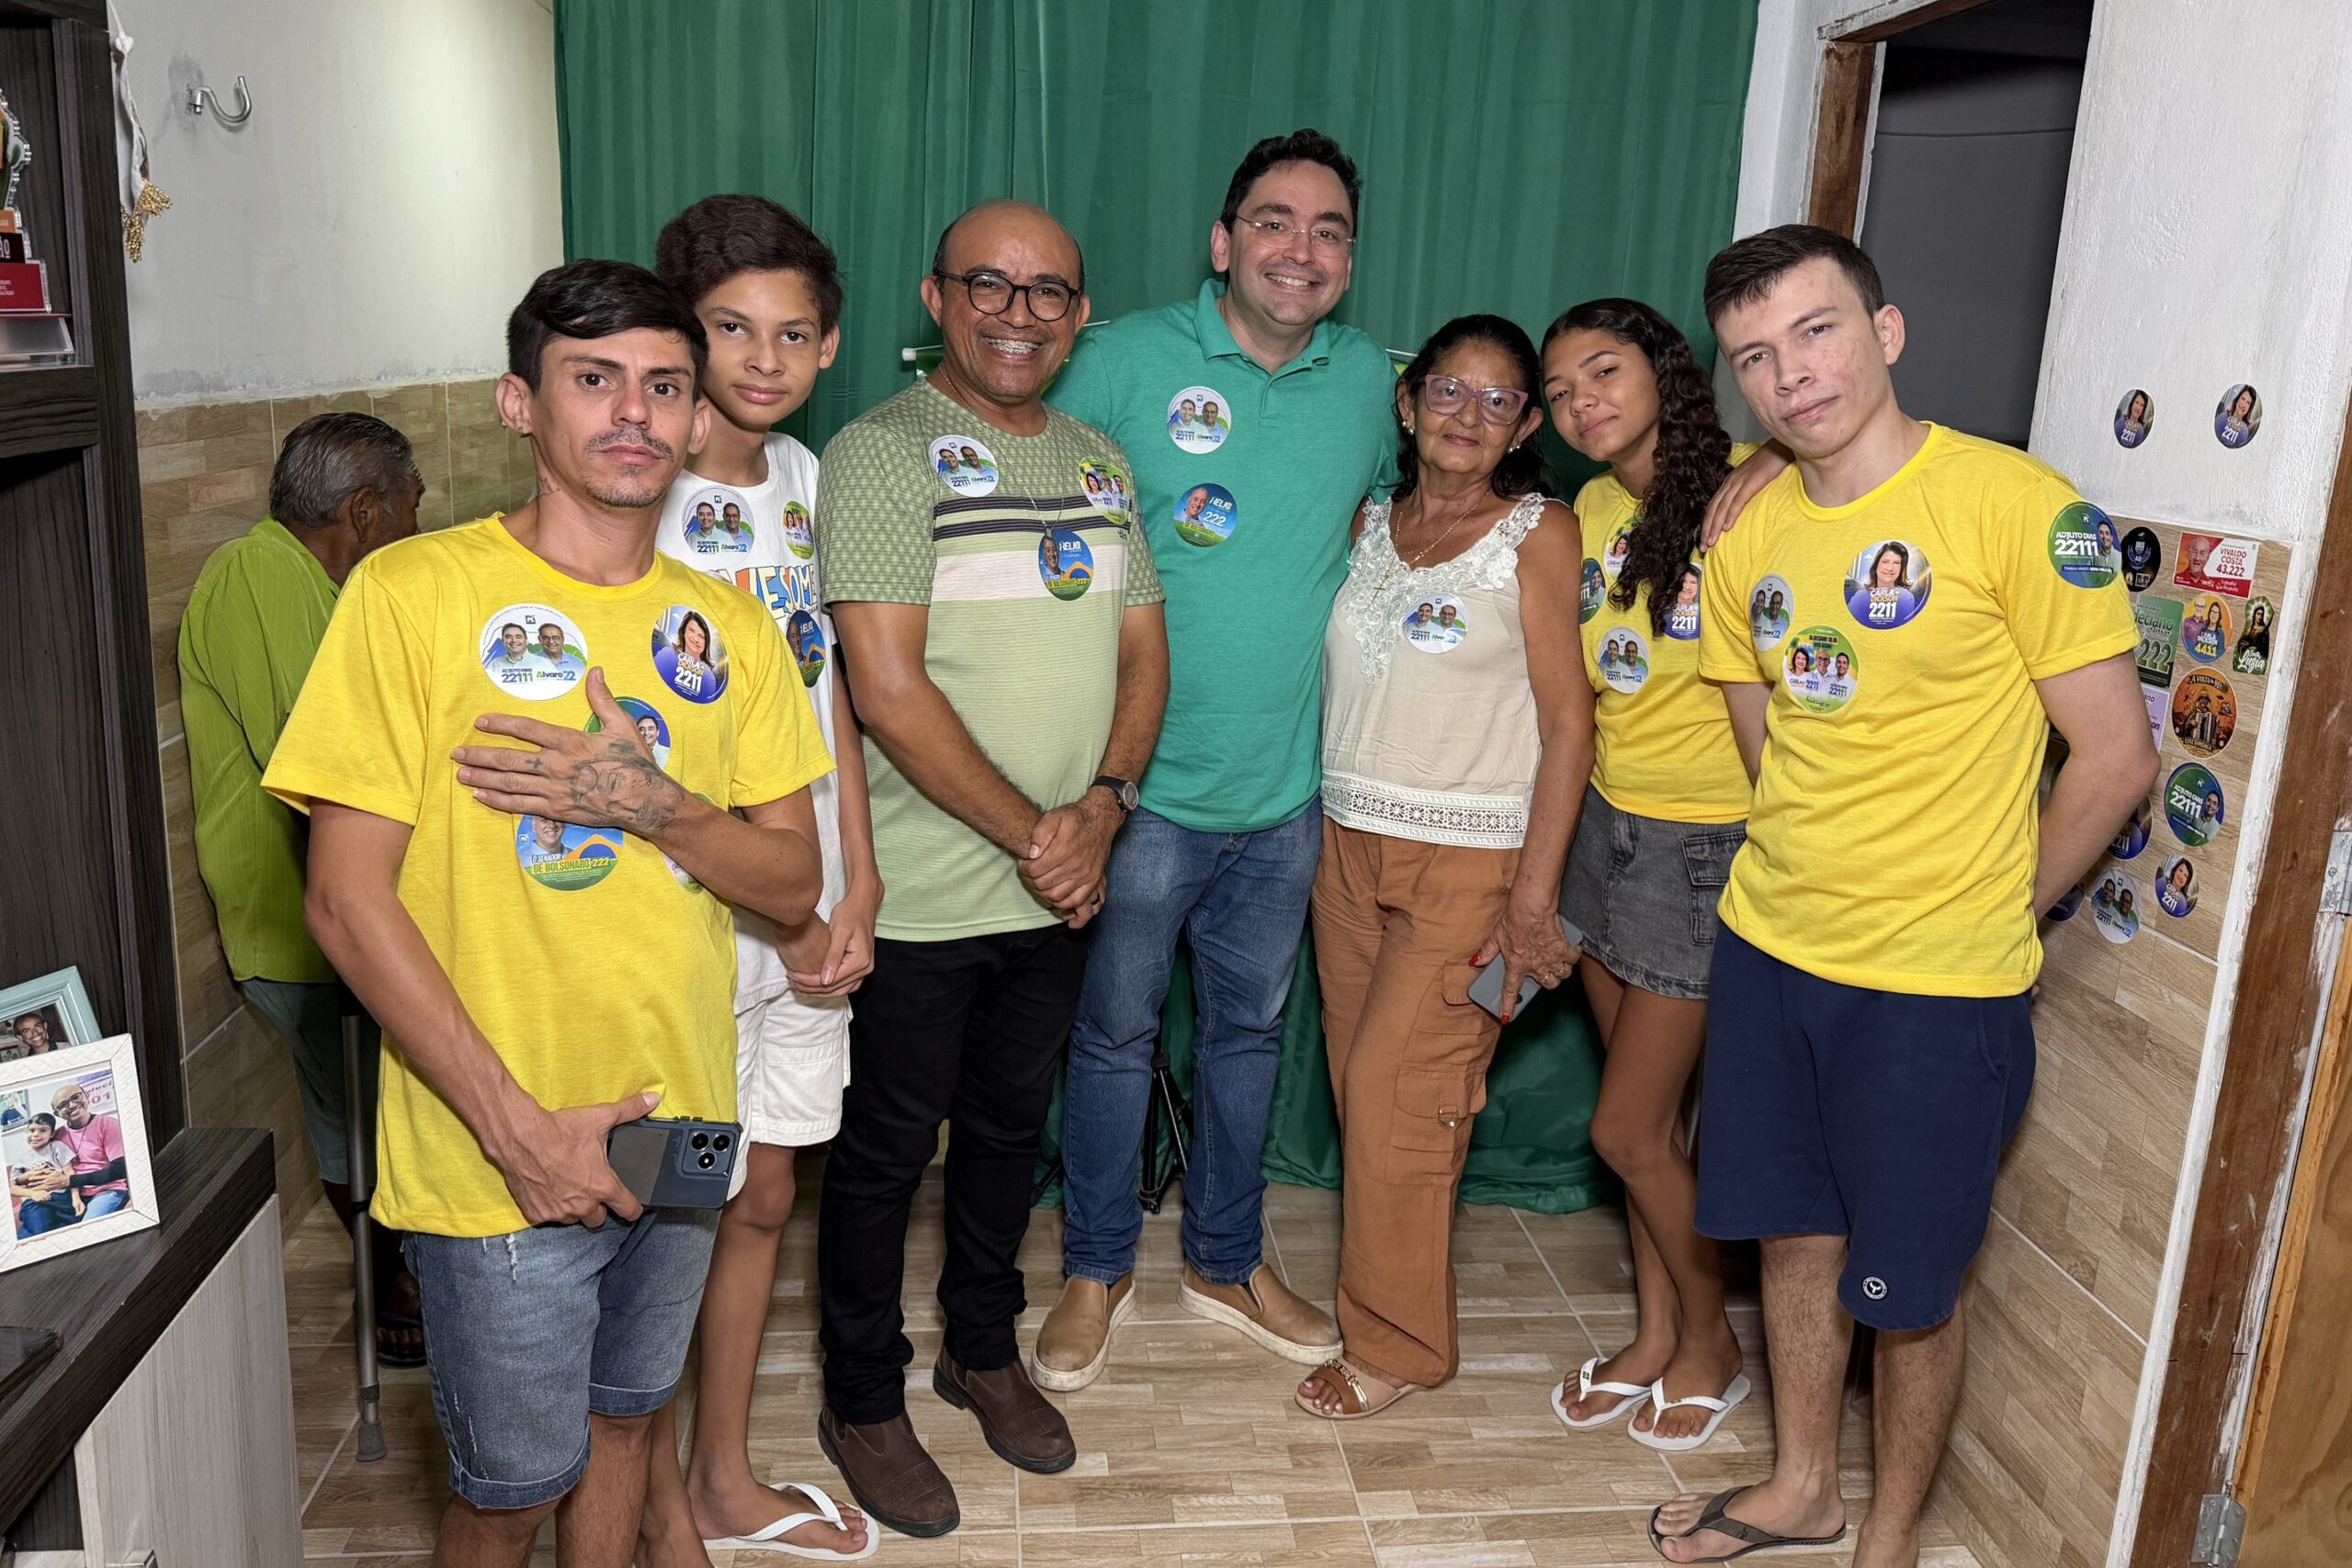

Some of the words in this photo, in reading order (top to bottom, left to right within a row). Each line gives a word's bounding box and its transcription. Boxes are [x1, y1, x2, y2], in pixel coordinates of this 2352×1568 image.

[2121, 429, 2136, 444] 2211
[2222, 426, 2239, 444] 2211
[1204, 512, 1227, 527] 222
[697, 545, 719, 553] 22111
[2054, 539, 2098, 556] 22111
[2221, 548, 2247, 558] VIVALDO
[2221, 556, 2244, 566] COSTA
[2216, 564, 2245, 578] 43.222
[707, 564, 818, 620] ESOME
[1580, 587, 1589, 601] 111
[1871, 589, 1894, 597] CARLA
[1869, 602, 1897, 618] 2211
[1672, 616, 1697, 630] 2211
[2195, 643, 2217, 657] 4411
[677, 652, 701, 669] CARLA
[502, 672, 533, 682] 22111
[563, 671, 576, 681] 22
[674, 666, 703, 692] 2211
[1805, 680, 1818, 691] 2211
[2170, 791, 2201, 818] 22111
[533, 863, 543, 874] DE
[545, 859, 590, 872] BOLSONARO
[592, 858, 610, 867] 222
[2162, 892, 2177, 911] 2211
